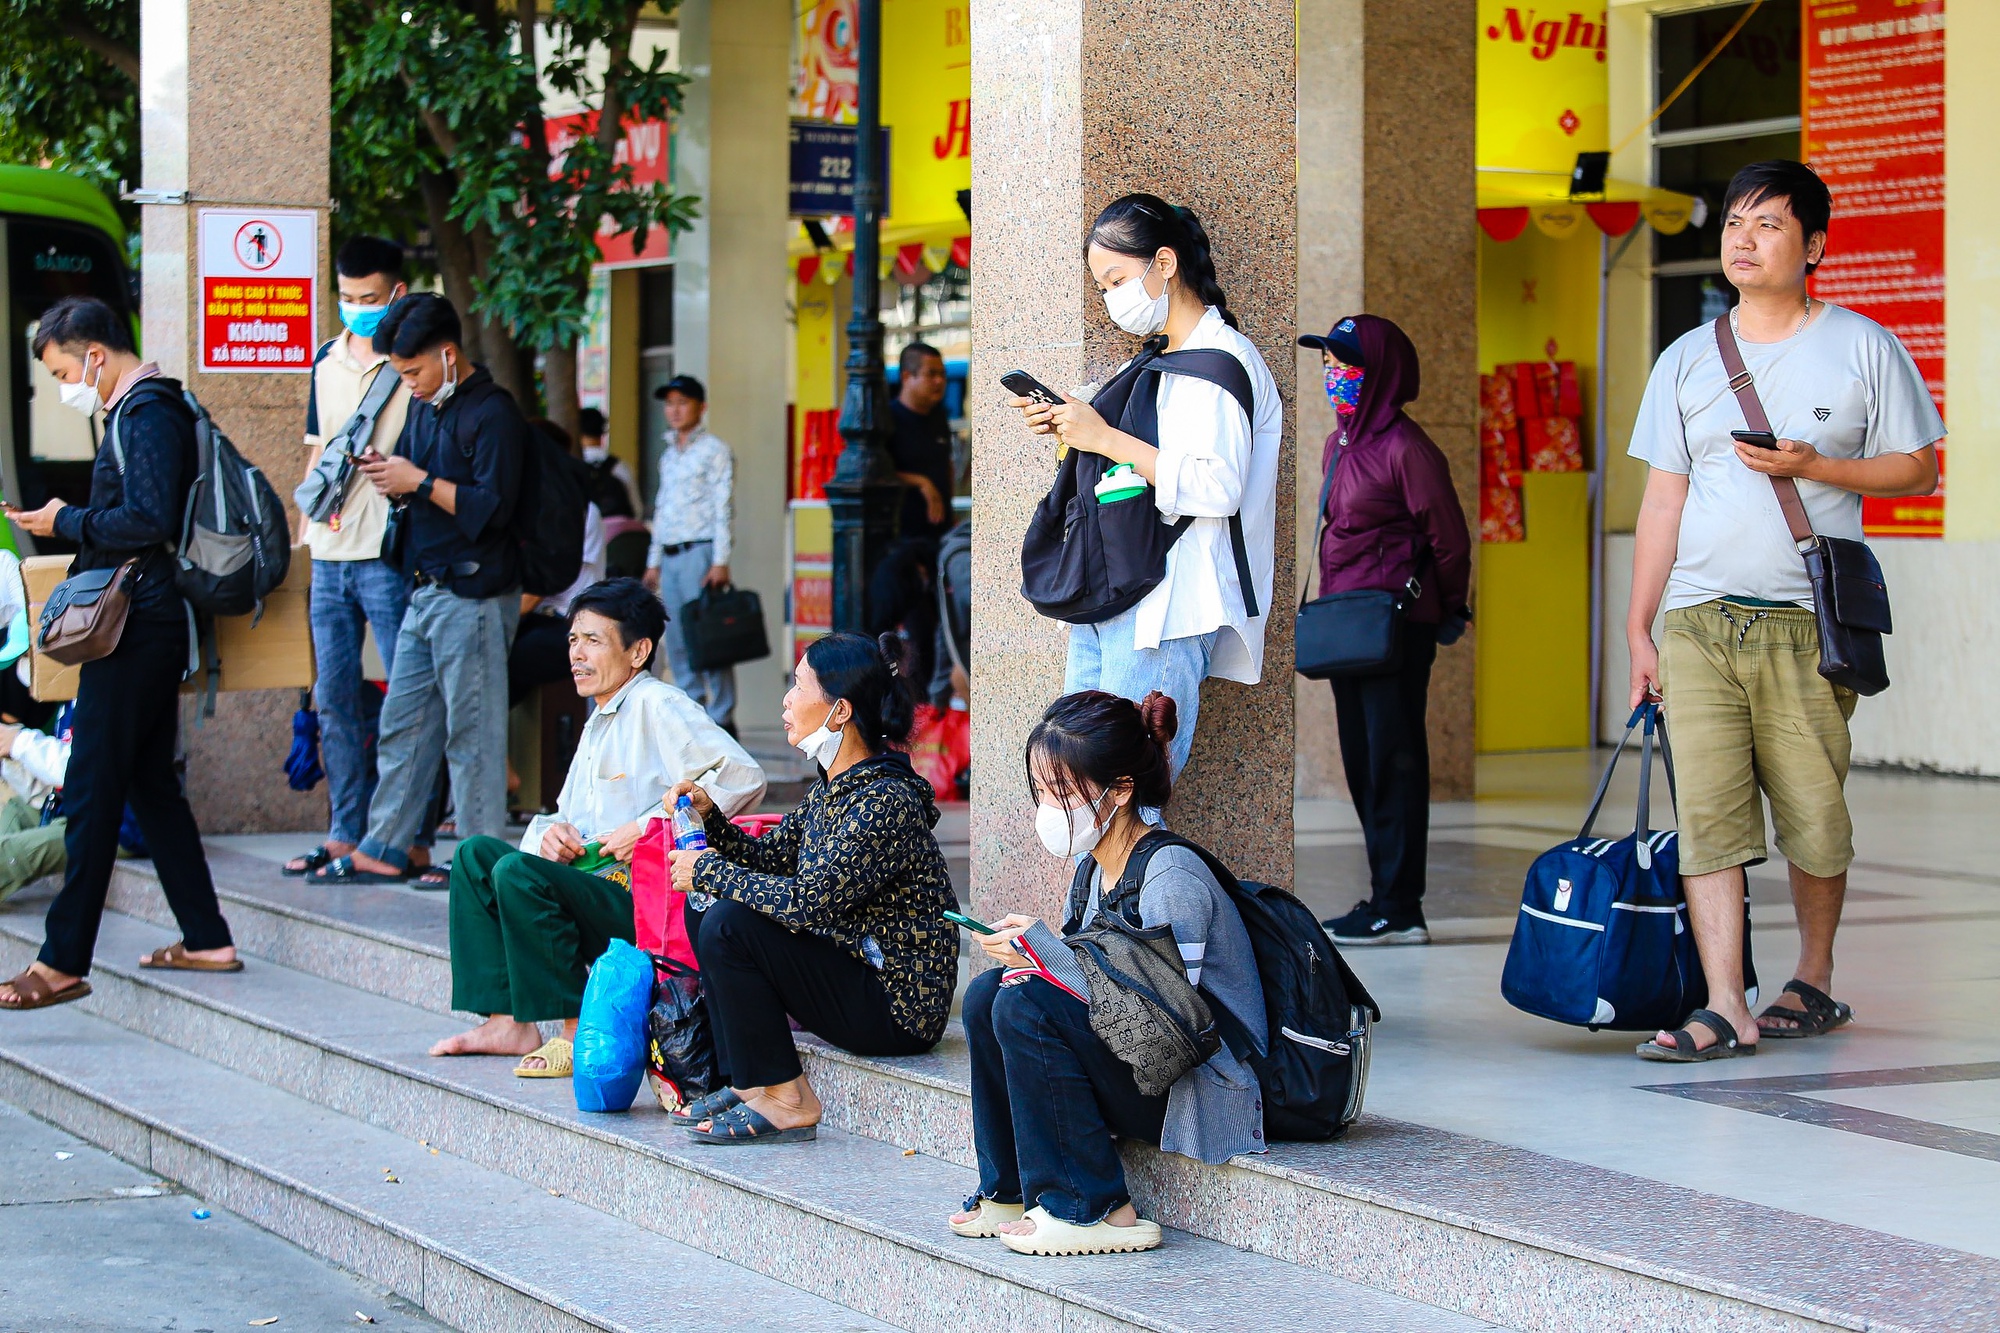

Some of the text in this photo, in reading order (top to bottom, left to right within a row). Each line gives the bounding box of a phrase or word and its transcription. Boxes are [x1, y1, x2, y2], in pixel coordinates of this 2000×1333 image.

[244, 286, 266, 299] CAO
[228, 318, 288, 342] KHÔNG
[230, 344, 256, 362] RÁC
